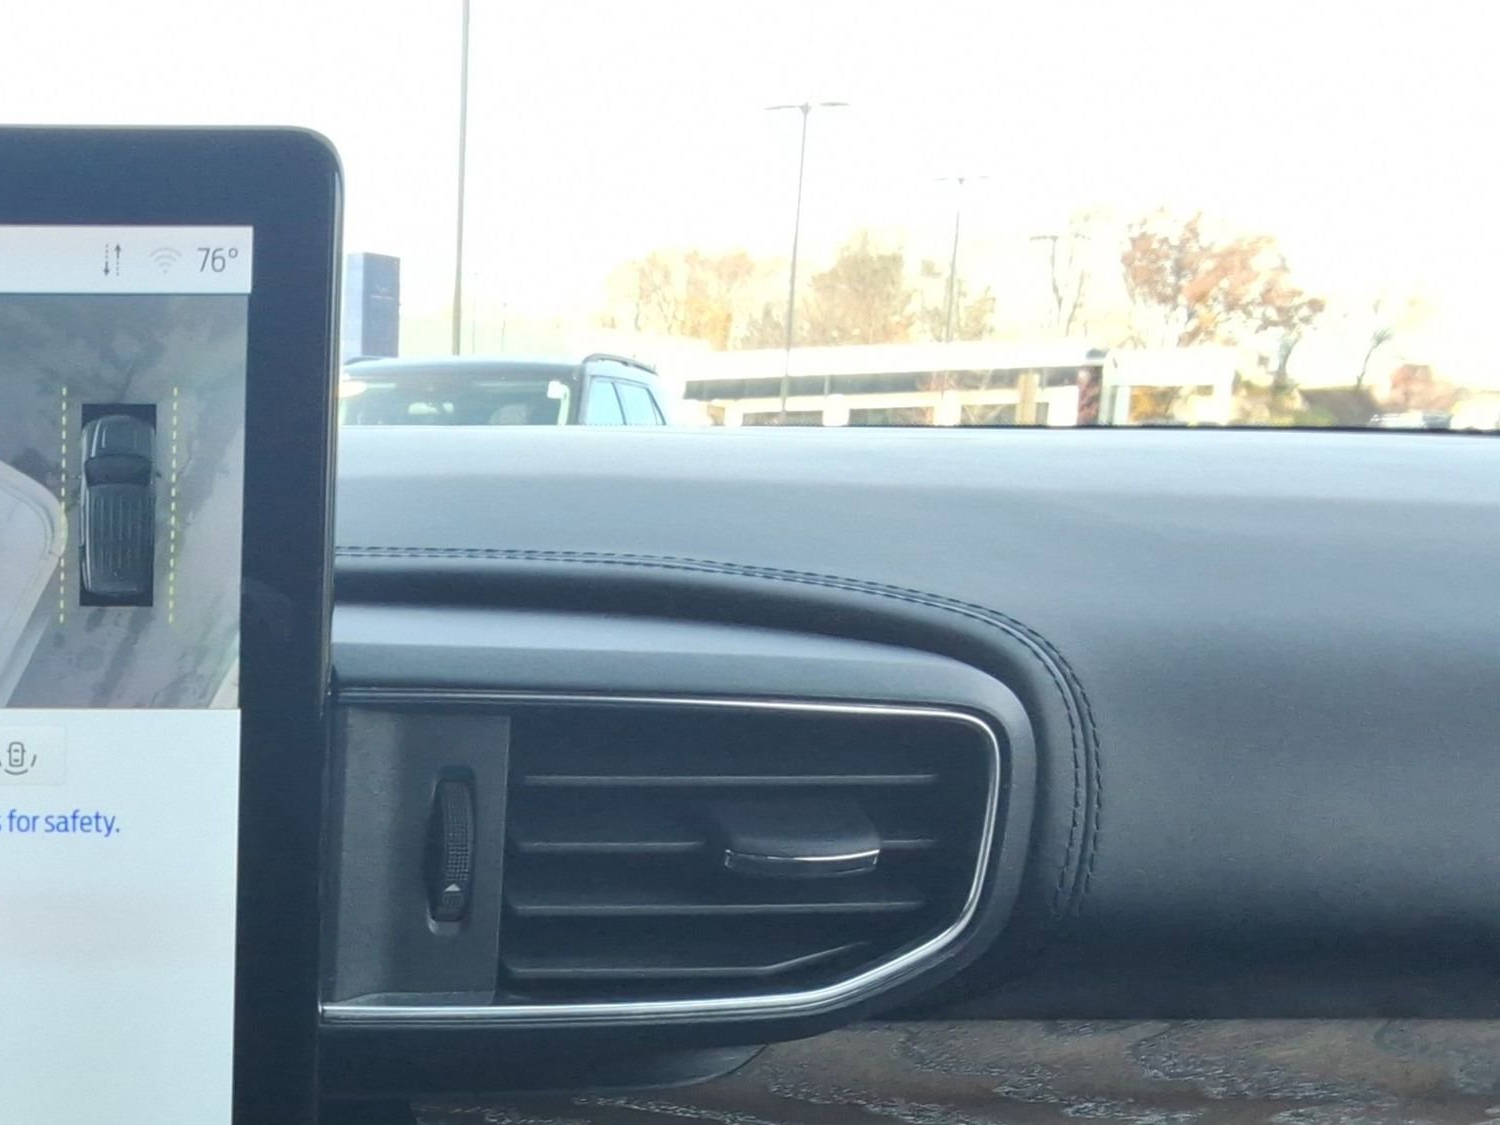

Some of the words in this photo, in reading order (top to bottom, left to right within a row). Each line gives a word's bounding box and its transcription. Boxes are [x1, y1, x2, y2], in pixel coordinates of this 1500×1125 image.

[197, 247, 239, 273] 76°
[7, 808, 40, 834] for
[44, 808, 121, 839] safety.
